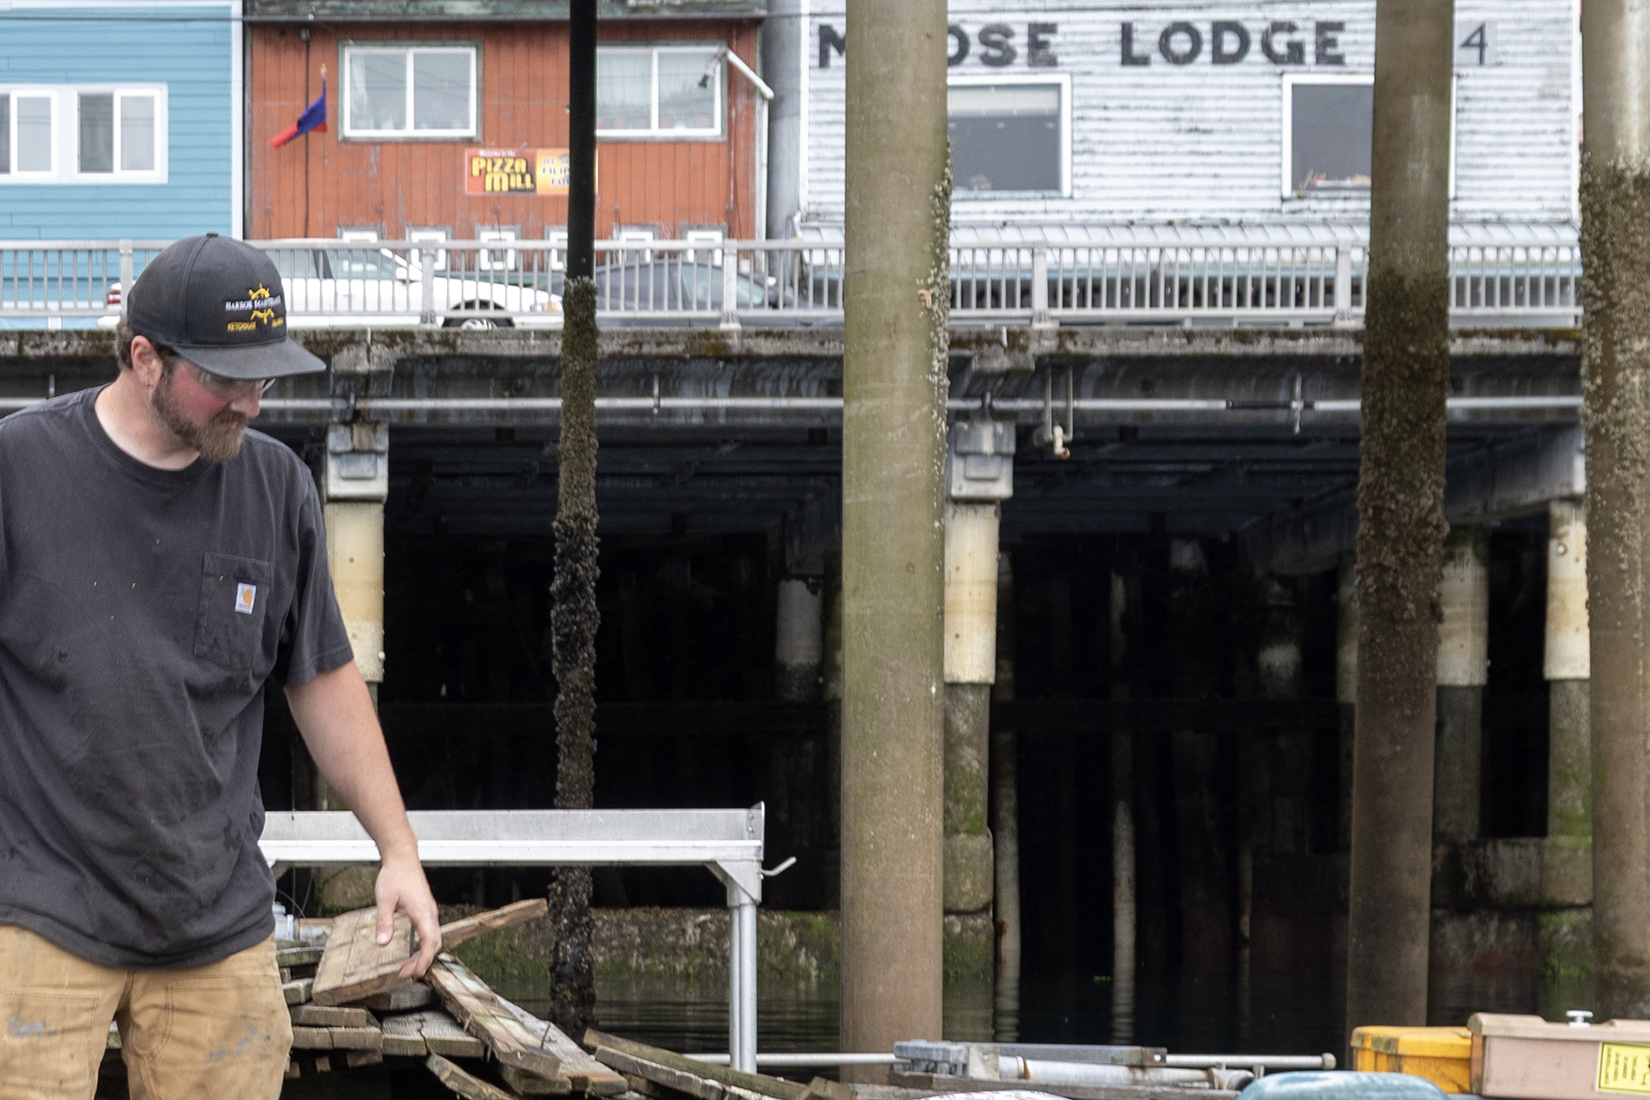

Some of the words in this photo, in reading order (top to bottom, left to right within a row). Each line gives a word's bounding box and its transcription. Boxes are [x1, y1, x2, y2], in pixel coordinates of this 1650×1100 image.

[819, 23, 1058, 68] MOSE
[1120, 21, 1346, 66] LODGE
[1459, 23, 1488, 66] 4
